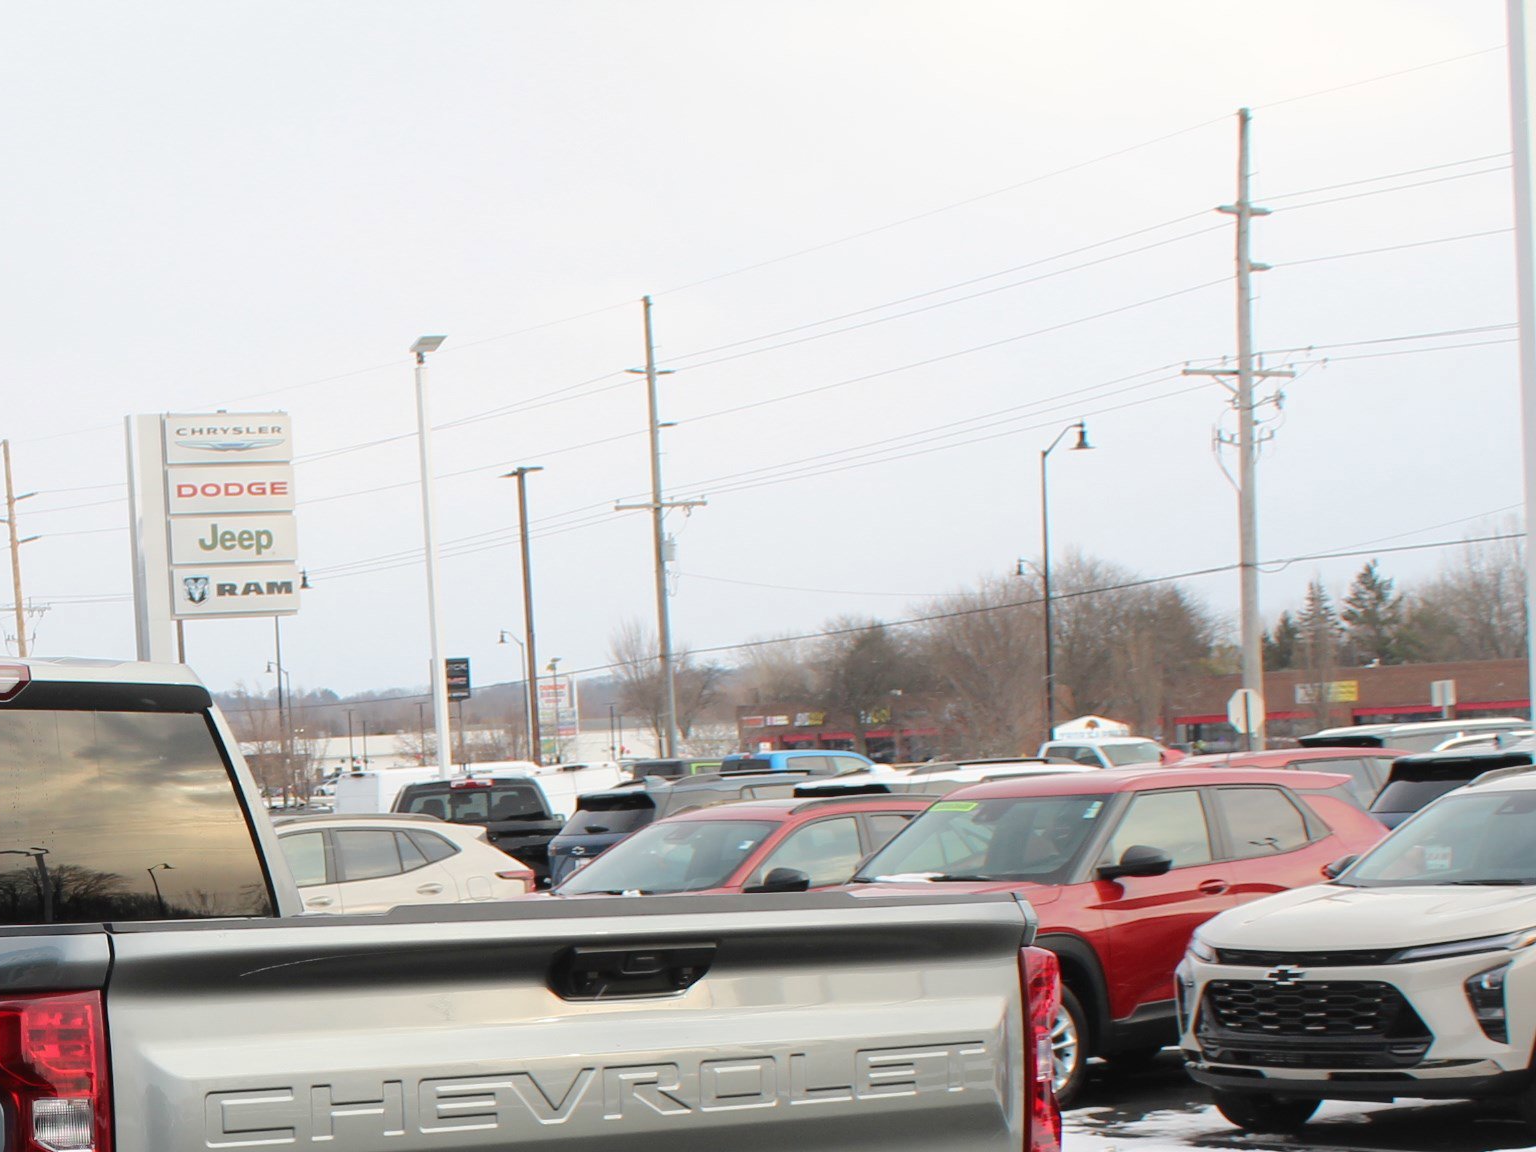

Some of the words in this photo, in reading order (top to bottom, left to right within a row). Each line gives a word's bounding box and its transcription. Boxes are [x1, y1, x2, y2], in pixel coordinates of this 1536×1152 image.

[175, 426, 283, 437] CHRYSLER
[176, 481, 289, 499] DODGE
[198, 523, 274, 555] Jeep
[216, 581, 294, 597] RAM
[204, 1040, 988, 1149] CHEVROLET
